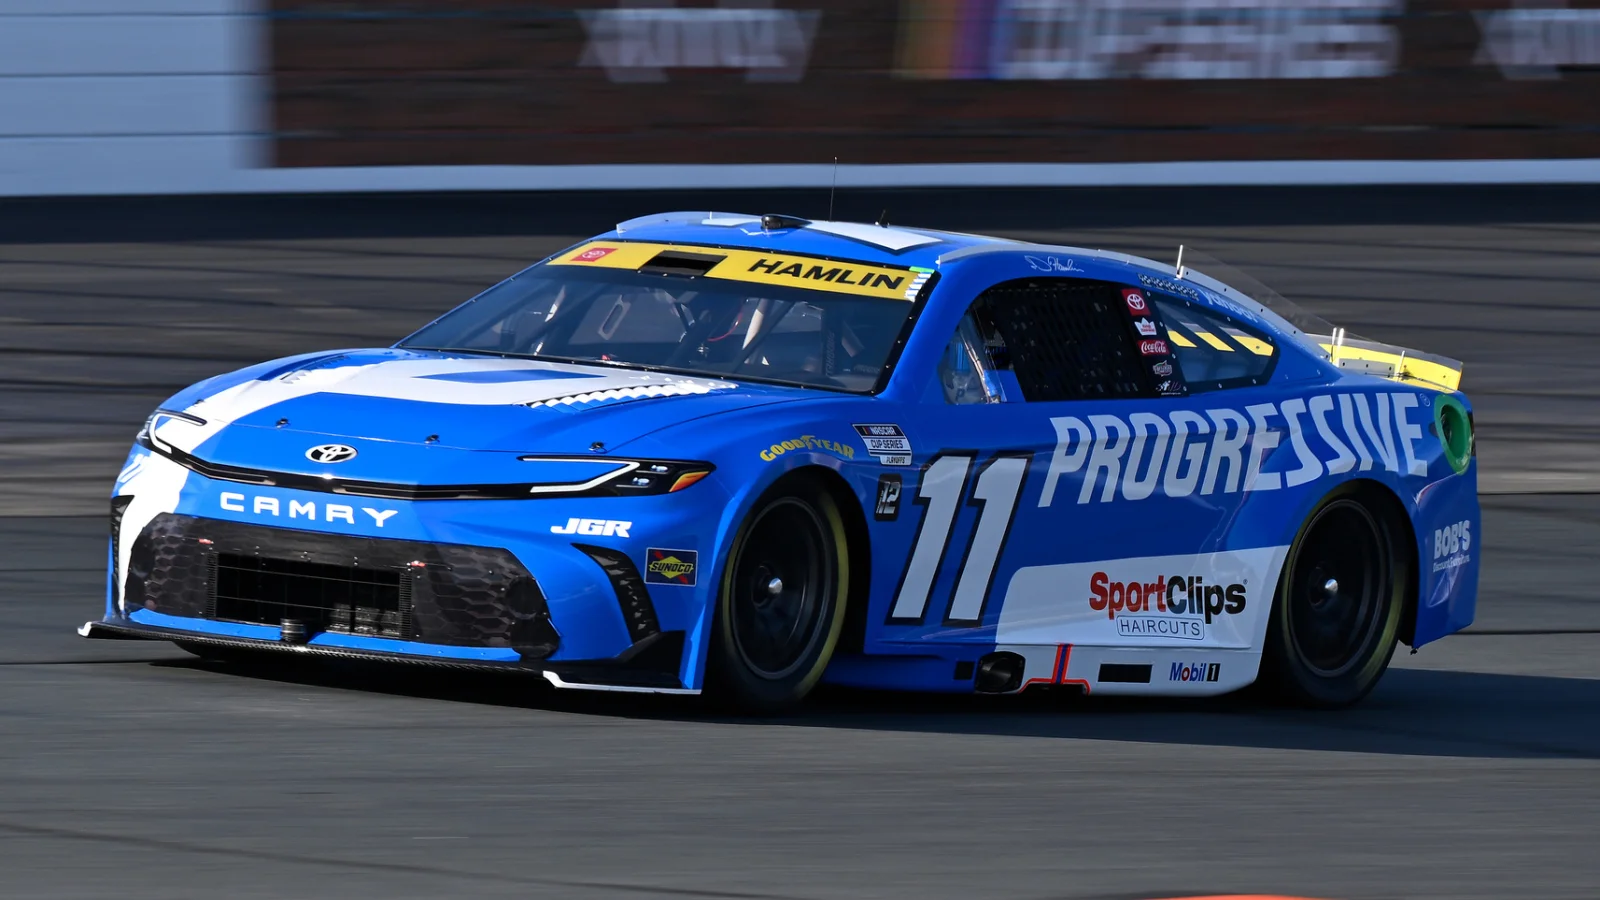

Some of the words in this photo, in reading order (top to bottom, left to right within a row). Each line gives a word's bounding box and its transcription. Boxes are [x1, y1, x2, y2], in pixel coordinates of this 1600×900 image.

[747, 258, 905, 290] HAMLIN
[870, 426, 897, 436] NASCAR
[759, 434, 855, 462] GOODYEAR
[870, 439, 883, 449] CUP
[883, 439, 904, 449] SERIES
[1037, 392, 1428, 508] PROGRESSIVE
[219, 491, 399, 528] CAMRY
[550, 517, 633, 538] JGR
[889, 454, 1031, 622] 11
[1433, 519, 1471, 560] BOB'S
[650, 561, 693, 573] SUNOCO
[1120, 619, 1201, 636] HAIRCUTS
[1169, 661, 1207, 682] Mobil
[1207, 663, 1220, 682] 1
